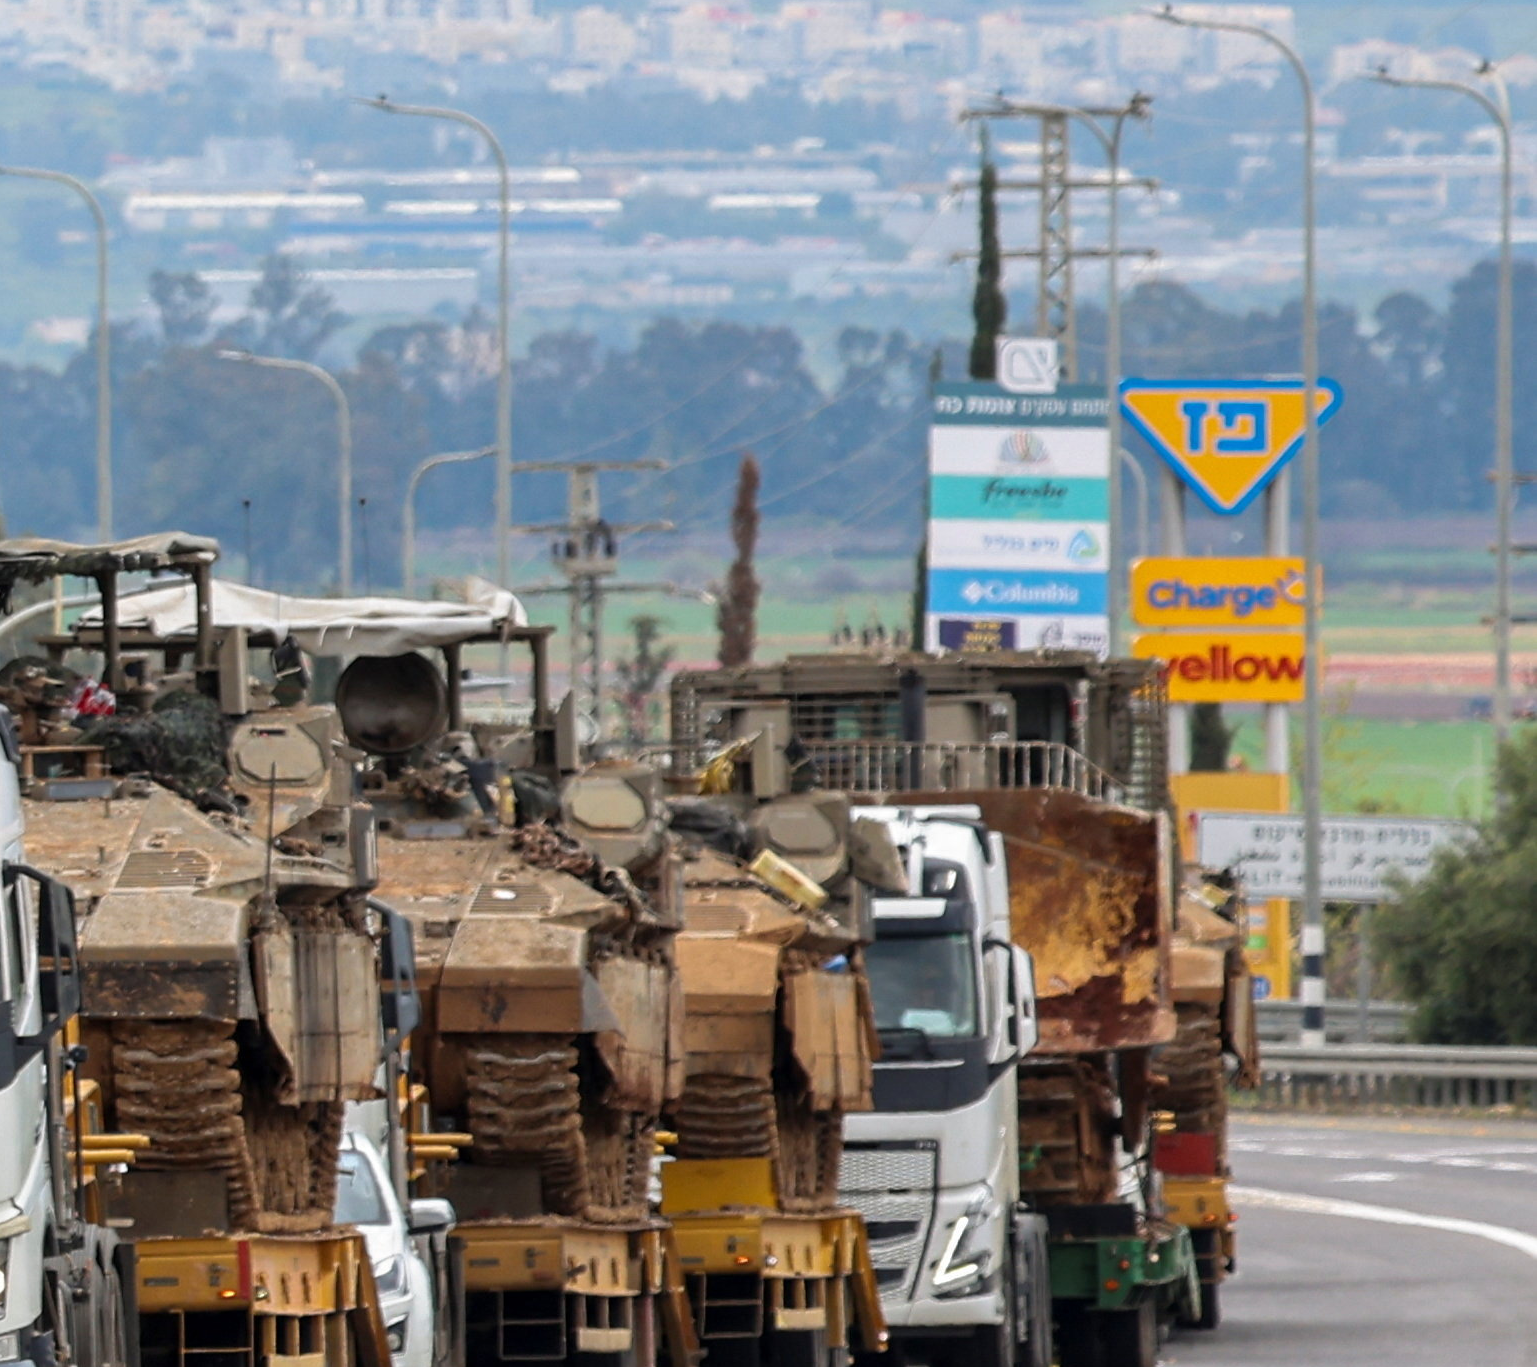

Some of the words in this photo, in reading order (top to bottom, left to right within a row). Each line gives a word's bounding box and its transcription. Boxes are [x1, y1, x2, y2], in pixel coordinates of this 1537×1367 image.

[1182, 399, 1267, 453] פז
[987, 581, 1080, 605] Columbia
[1146, 579, 1279, 618] Charge
